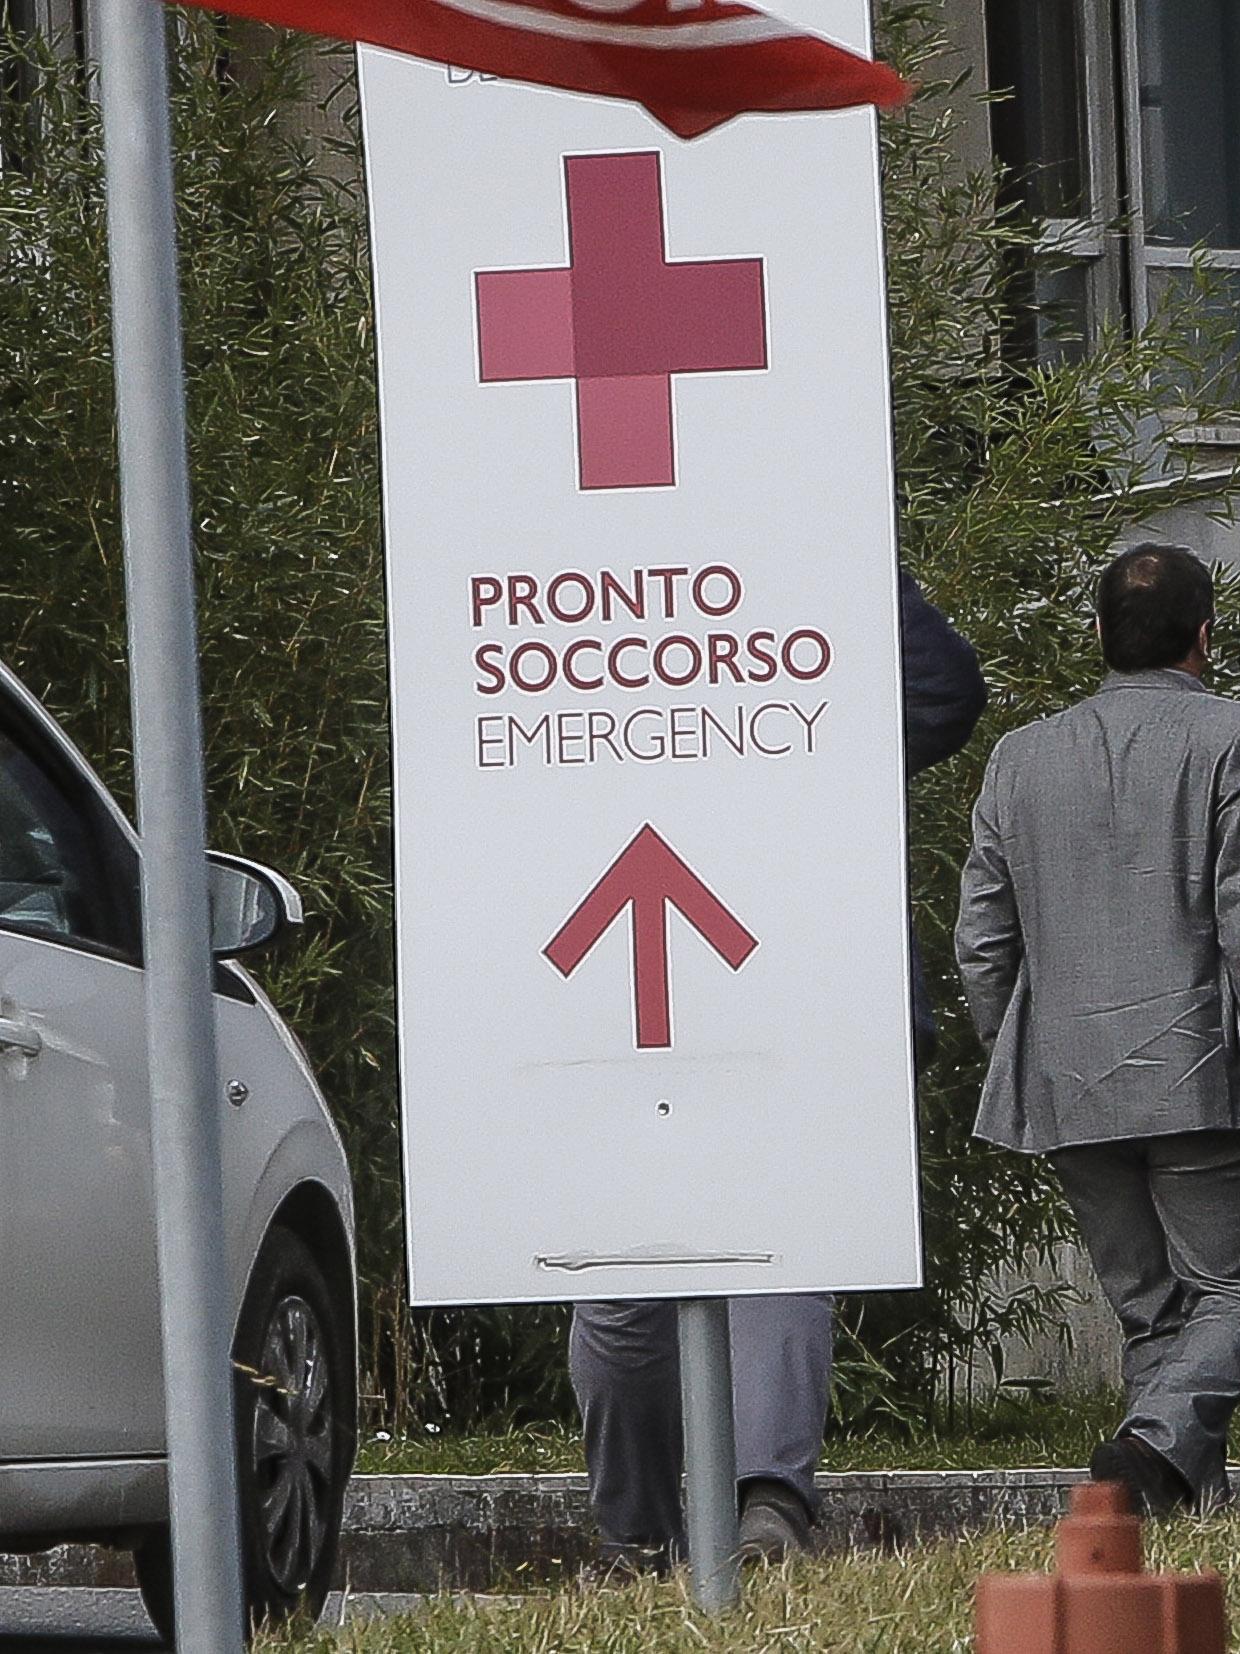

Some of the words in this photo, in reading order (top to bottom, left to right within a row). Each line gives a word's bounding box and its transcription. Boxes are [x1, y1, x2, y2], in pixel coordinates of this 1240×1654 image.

[471, 566, 741, 626] PRONTO
[476, 630, 830, 694] SOCCORSO
[478, 702, 827, 767] EMERGENCY
